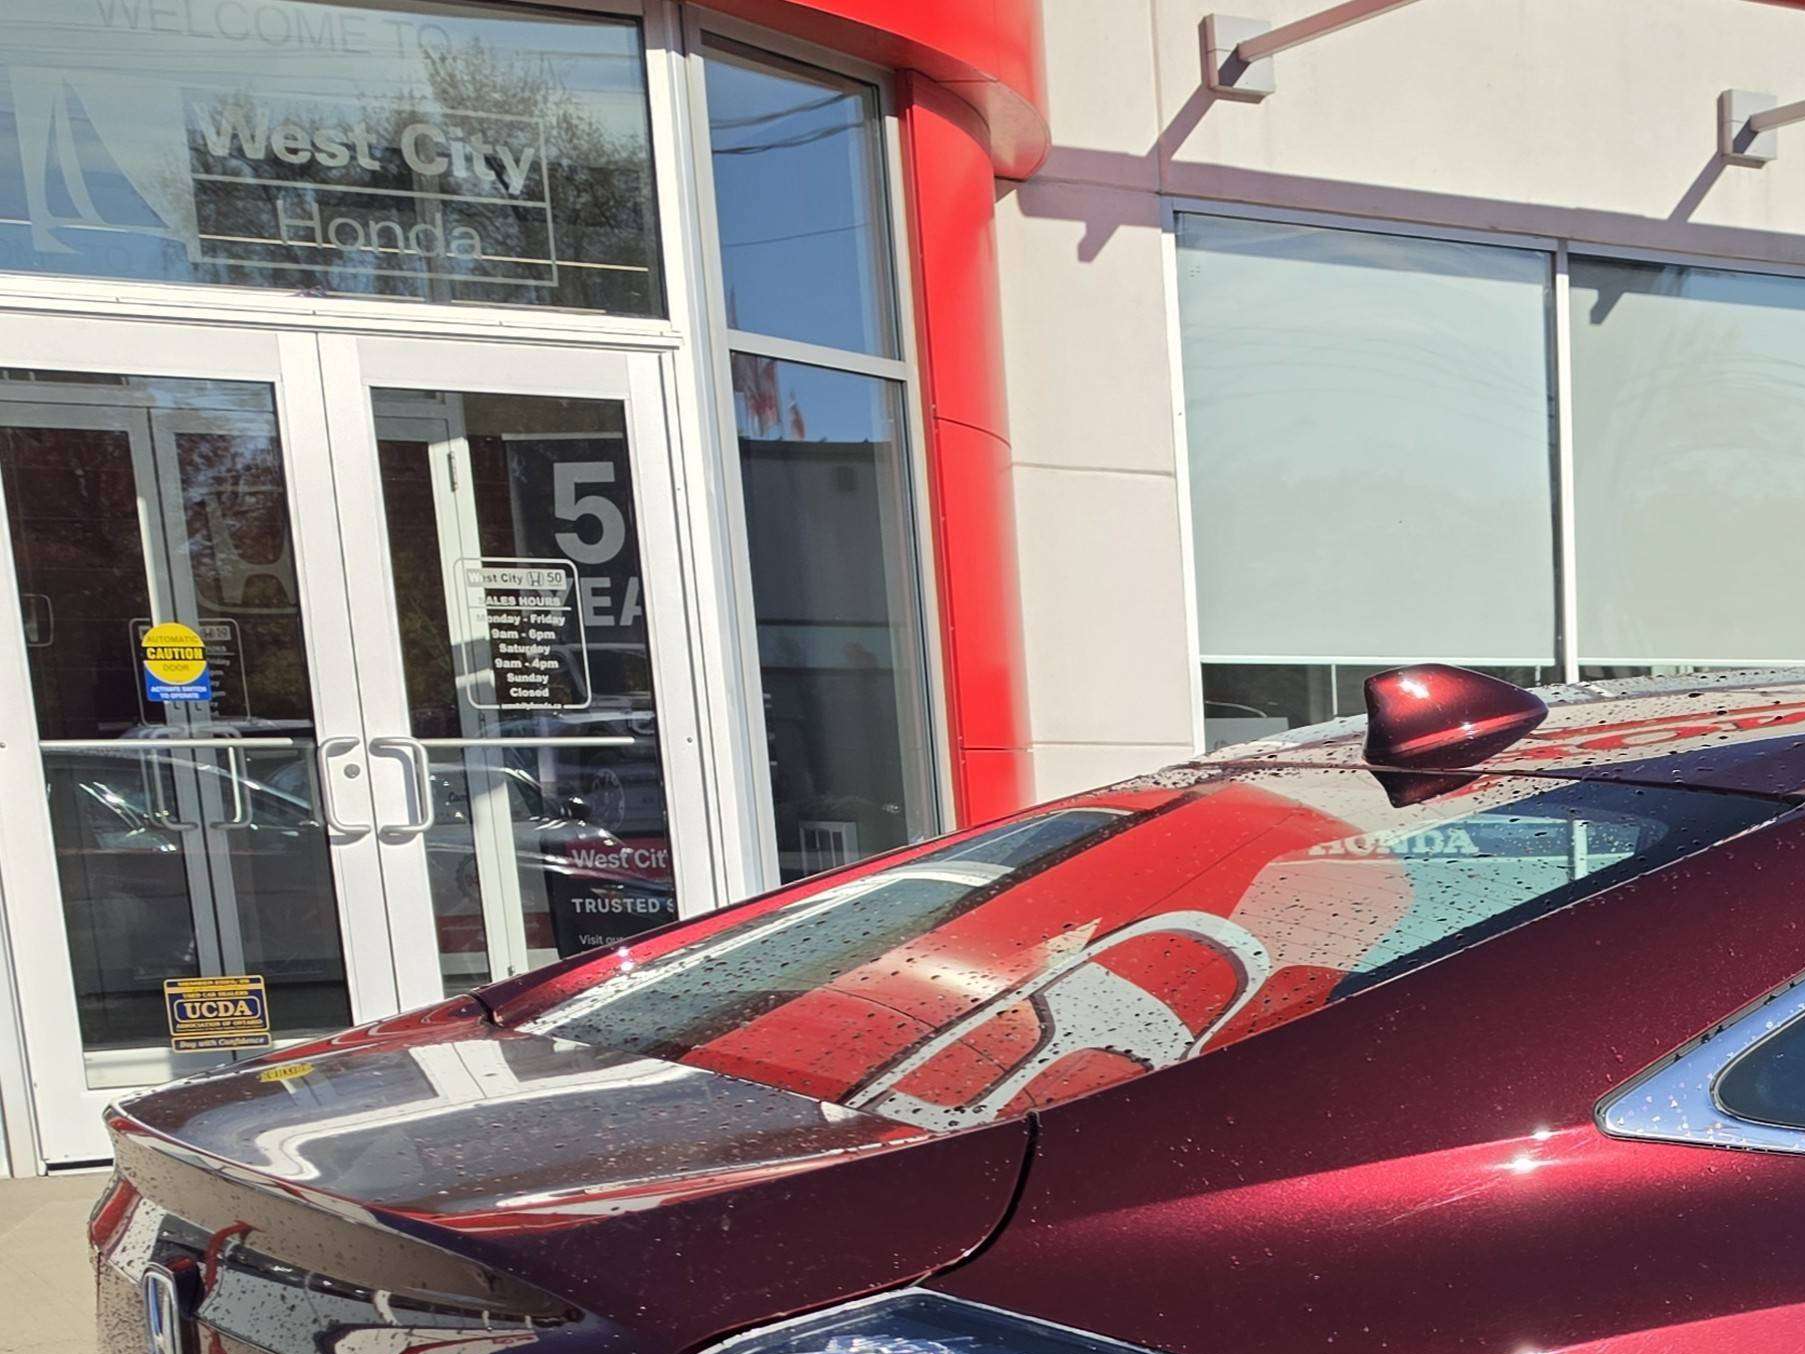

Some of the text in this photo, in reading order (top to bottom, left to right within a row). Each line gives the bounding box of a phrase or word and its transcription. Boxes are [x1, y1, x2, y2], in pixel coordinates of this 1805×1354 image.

[96, 0, 372, 56] WELCOME
[190, 101, 536, 196] West City
[276, 197, 486, 261] Honda
[501, 572, 523, 585] City
[547, 571, 562, 584] 50
[519, 596, 560, 607] HOURS
[530, 613, 565, 627] Friday
[146, 635, 199, 643] AUTOMATIC
[491, 628, 519, 639] 9am
[528, 628, 556, 641] 6pm
[146, 647, 204, 660] CAUTION
[498, 643, 551, 655] Saturday
[494, 658, 522, 669] 9am
[532, 658, 559, 670] 4pm
[506, 672, 549, 684] Sunday
[509, 687, 550, 698] Closed
[572, 847, 669, 868] West Cit
[571, 897, 660, 913] TRUSTED
[578, 934, 603, 945] Visit
[183, 1000, 253, 1019] UCDA
